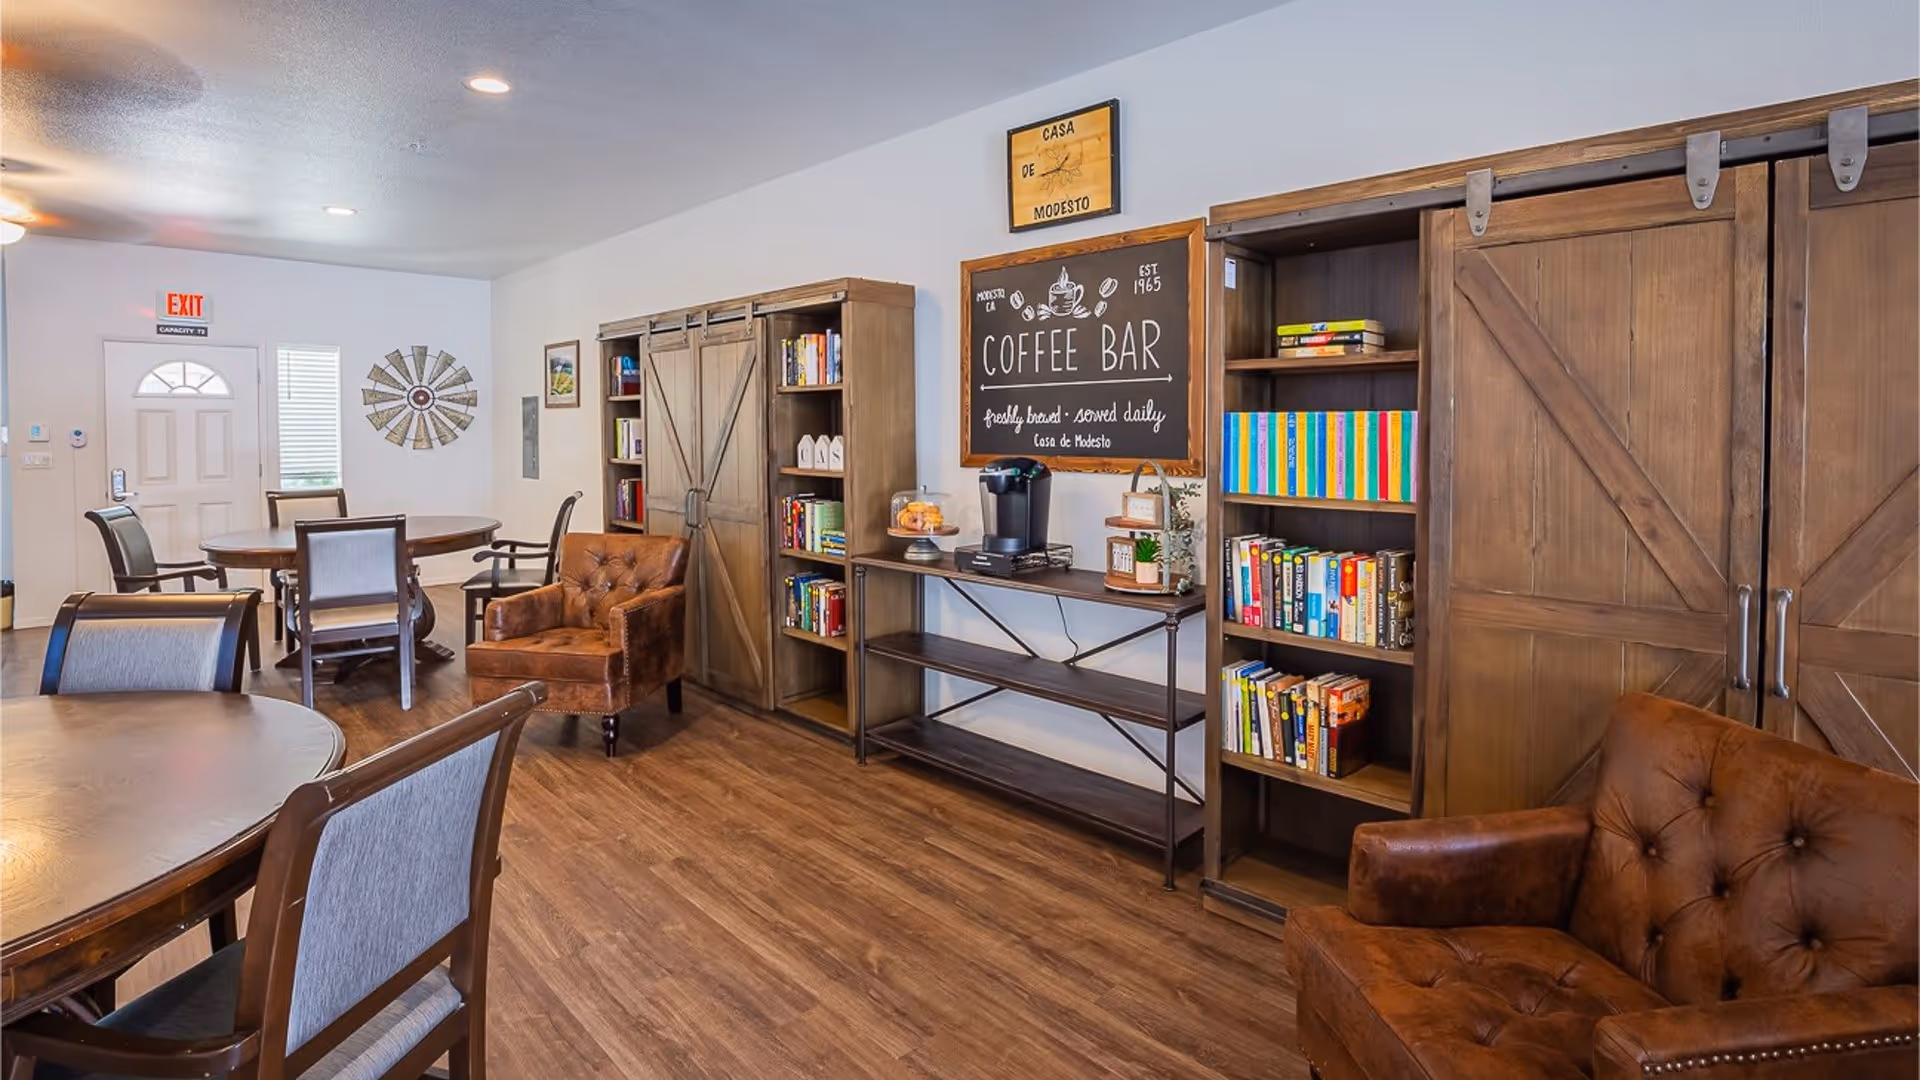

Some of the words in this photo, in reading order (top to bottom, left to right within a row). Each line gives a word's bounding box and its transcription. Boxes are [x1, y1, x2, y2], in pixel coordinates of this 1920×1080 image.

[1042, 121, 1074, 141] CASA
[1021, 163, 1035, 178] DE
[1033, 195, 1090, 220] MODESTO
[976, 288, 1006, 302] MODESTO
[1133, 276, 1162, 295] 1965
[167, 293, 204, 317] EXIT
[985, 302, 997, 313] CA
[983, 328, 1078, 376] COFFEE
[1101, 319, 1161, 372] BAR
[983, 405, 1025, 434] freshly
[1026, 404, 1062, 425] brewed
[1073, 401, 1118, 423] served
[1123, 399, 1166, 433] daily
[1033, 433, 1056, 448] Casa
[1060, 433, 1072, 448] de
[1074, 434, 1112, 449] Modesto
